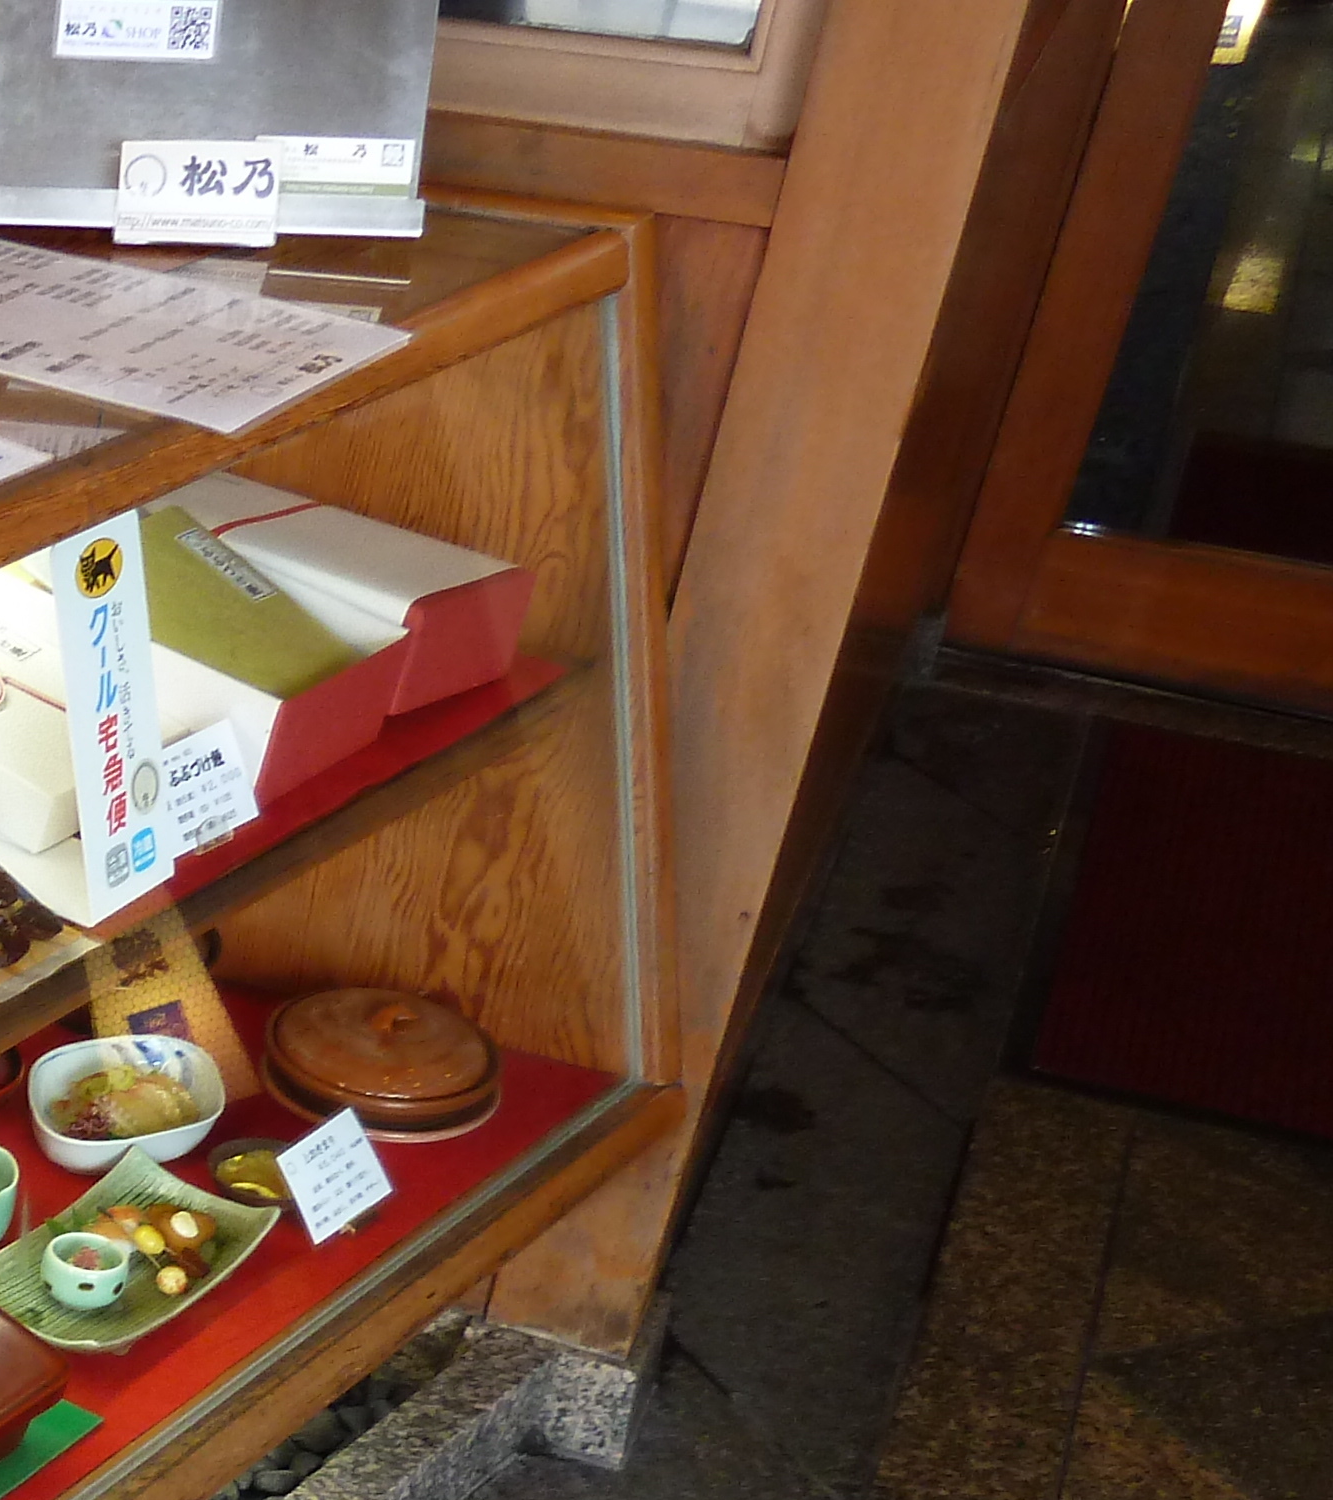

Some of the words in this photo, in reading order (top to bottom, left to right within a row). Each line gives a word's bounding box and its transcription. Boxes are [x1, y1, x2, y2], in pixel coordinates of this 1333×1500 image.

[181, 155, 275, 198] 松乃
[89, 603, 127, 837] クール宅急便
